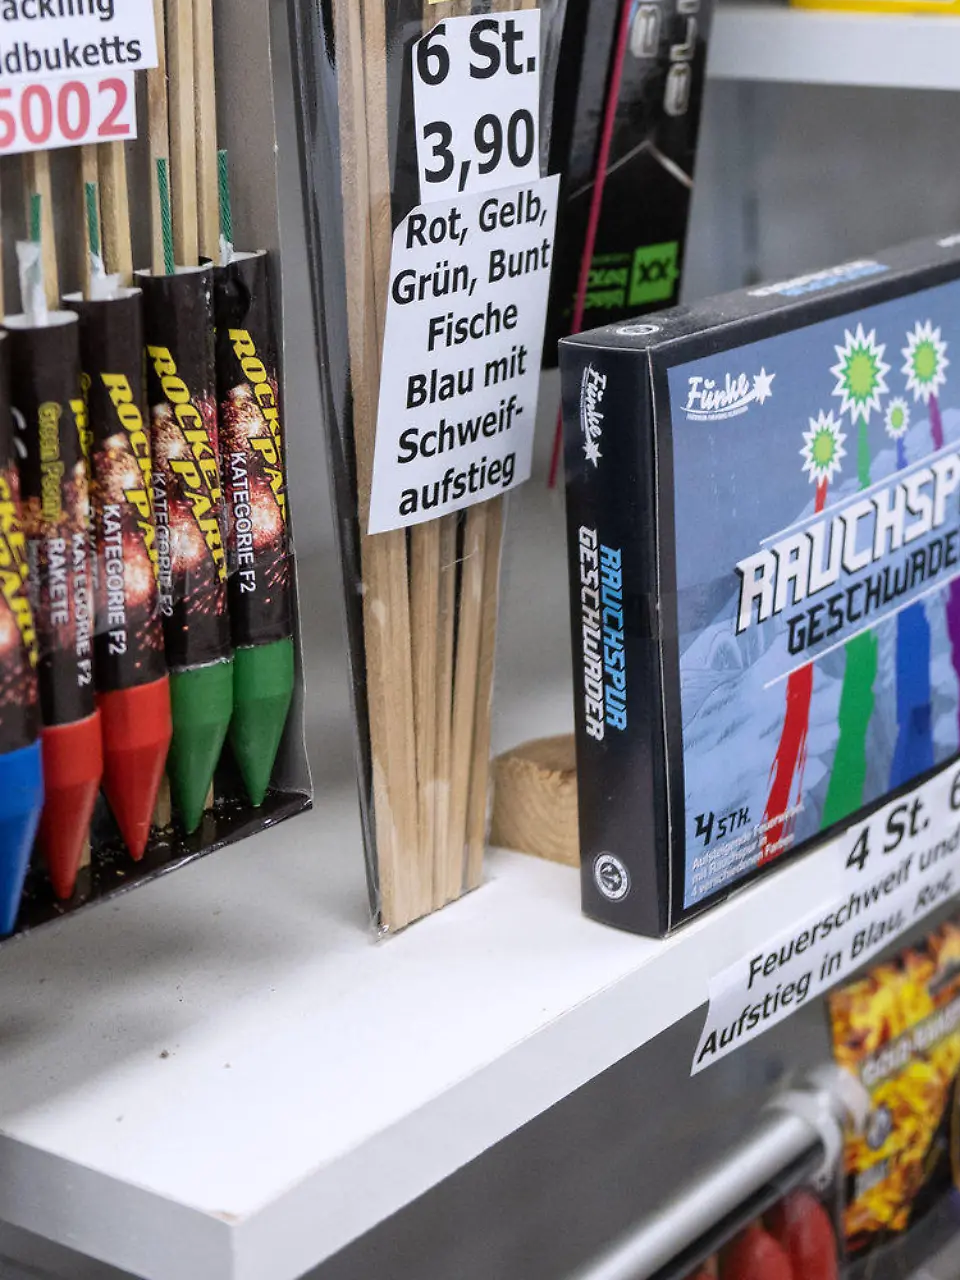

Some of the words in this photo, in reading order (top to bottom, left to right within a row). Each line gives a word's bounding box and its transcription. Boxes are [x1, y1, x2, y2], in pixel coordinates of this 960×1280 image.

[1, 35, 143, 75] dbuketts
[416, 23, 450, 86] 6
[469, 18, 536, 80] St.
[423, 108, 535, 192] 3,90
[406, 207, 469, 250] Rot,
[478, 189, 548, 234] Gelb,
[391, 260, 478, 306] Grün,
[488, 238, 551, 284] Bunt
[427, 301, 518, 352] Fische
[405, 368, 475, 410] Blau
[483, 344, 528, 388] mit
[397, 395, 525, 465] Schweif-
[229, 452, 255, 566] KATEGORIE
[398, 452, 517, 517] aufstieg
[103, 503, 126, 625] KATEGORIE
[152, 472, 174, 589] KATEGORIE
[47, 537, 69, 626] RAKETE
[72, 532, 91, 656] KATEGORIE
[159, 589, 174, 618] F2
[237, 568, 257, 594] F2
[108, 626, 127, 656] F2
[578, 524, 605, 742] GESCHWADER
[599, 542, 628, 733] RAUCHSPUR
[76, 659, 92, 687] F2
[694, 811, 716, 847] 4
[845, 826, 872, 873] 4
[881, 797, 931, 855] St.
[746, 854, 915, 991] Feuerschweif
[697, 967, 813, 1065] Aufstieg
[818, 953, 844, 983] in
[849, 908, 906, 960] Blau,
[913, 871, 955, 913] Rot,
